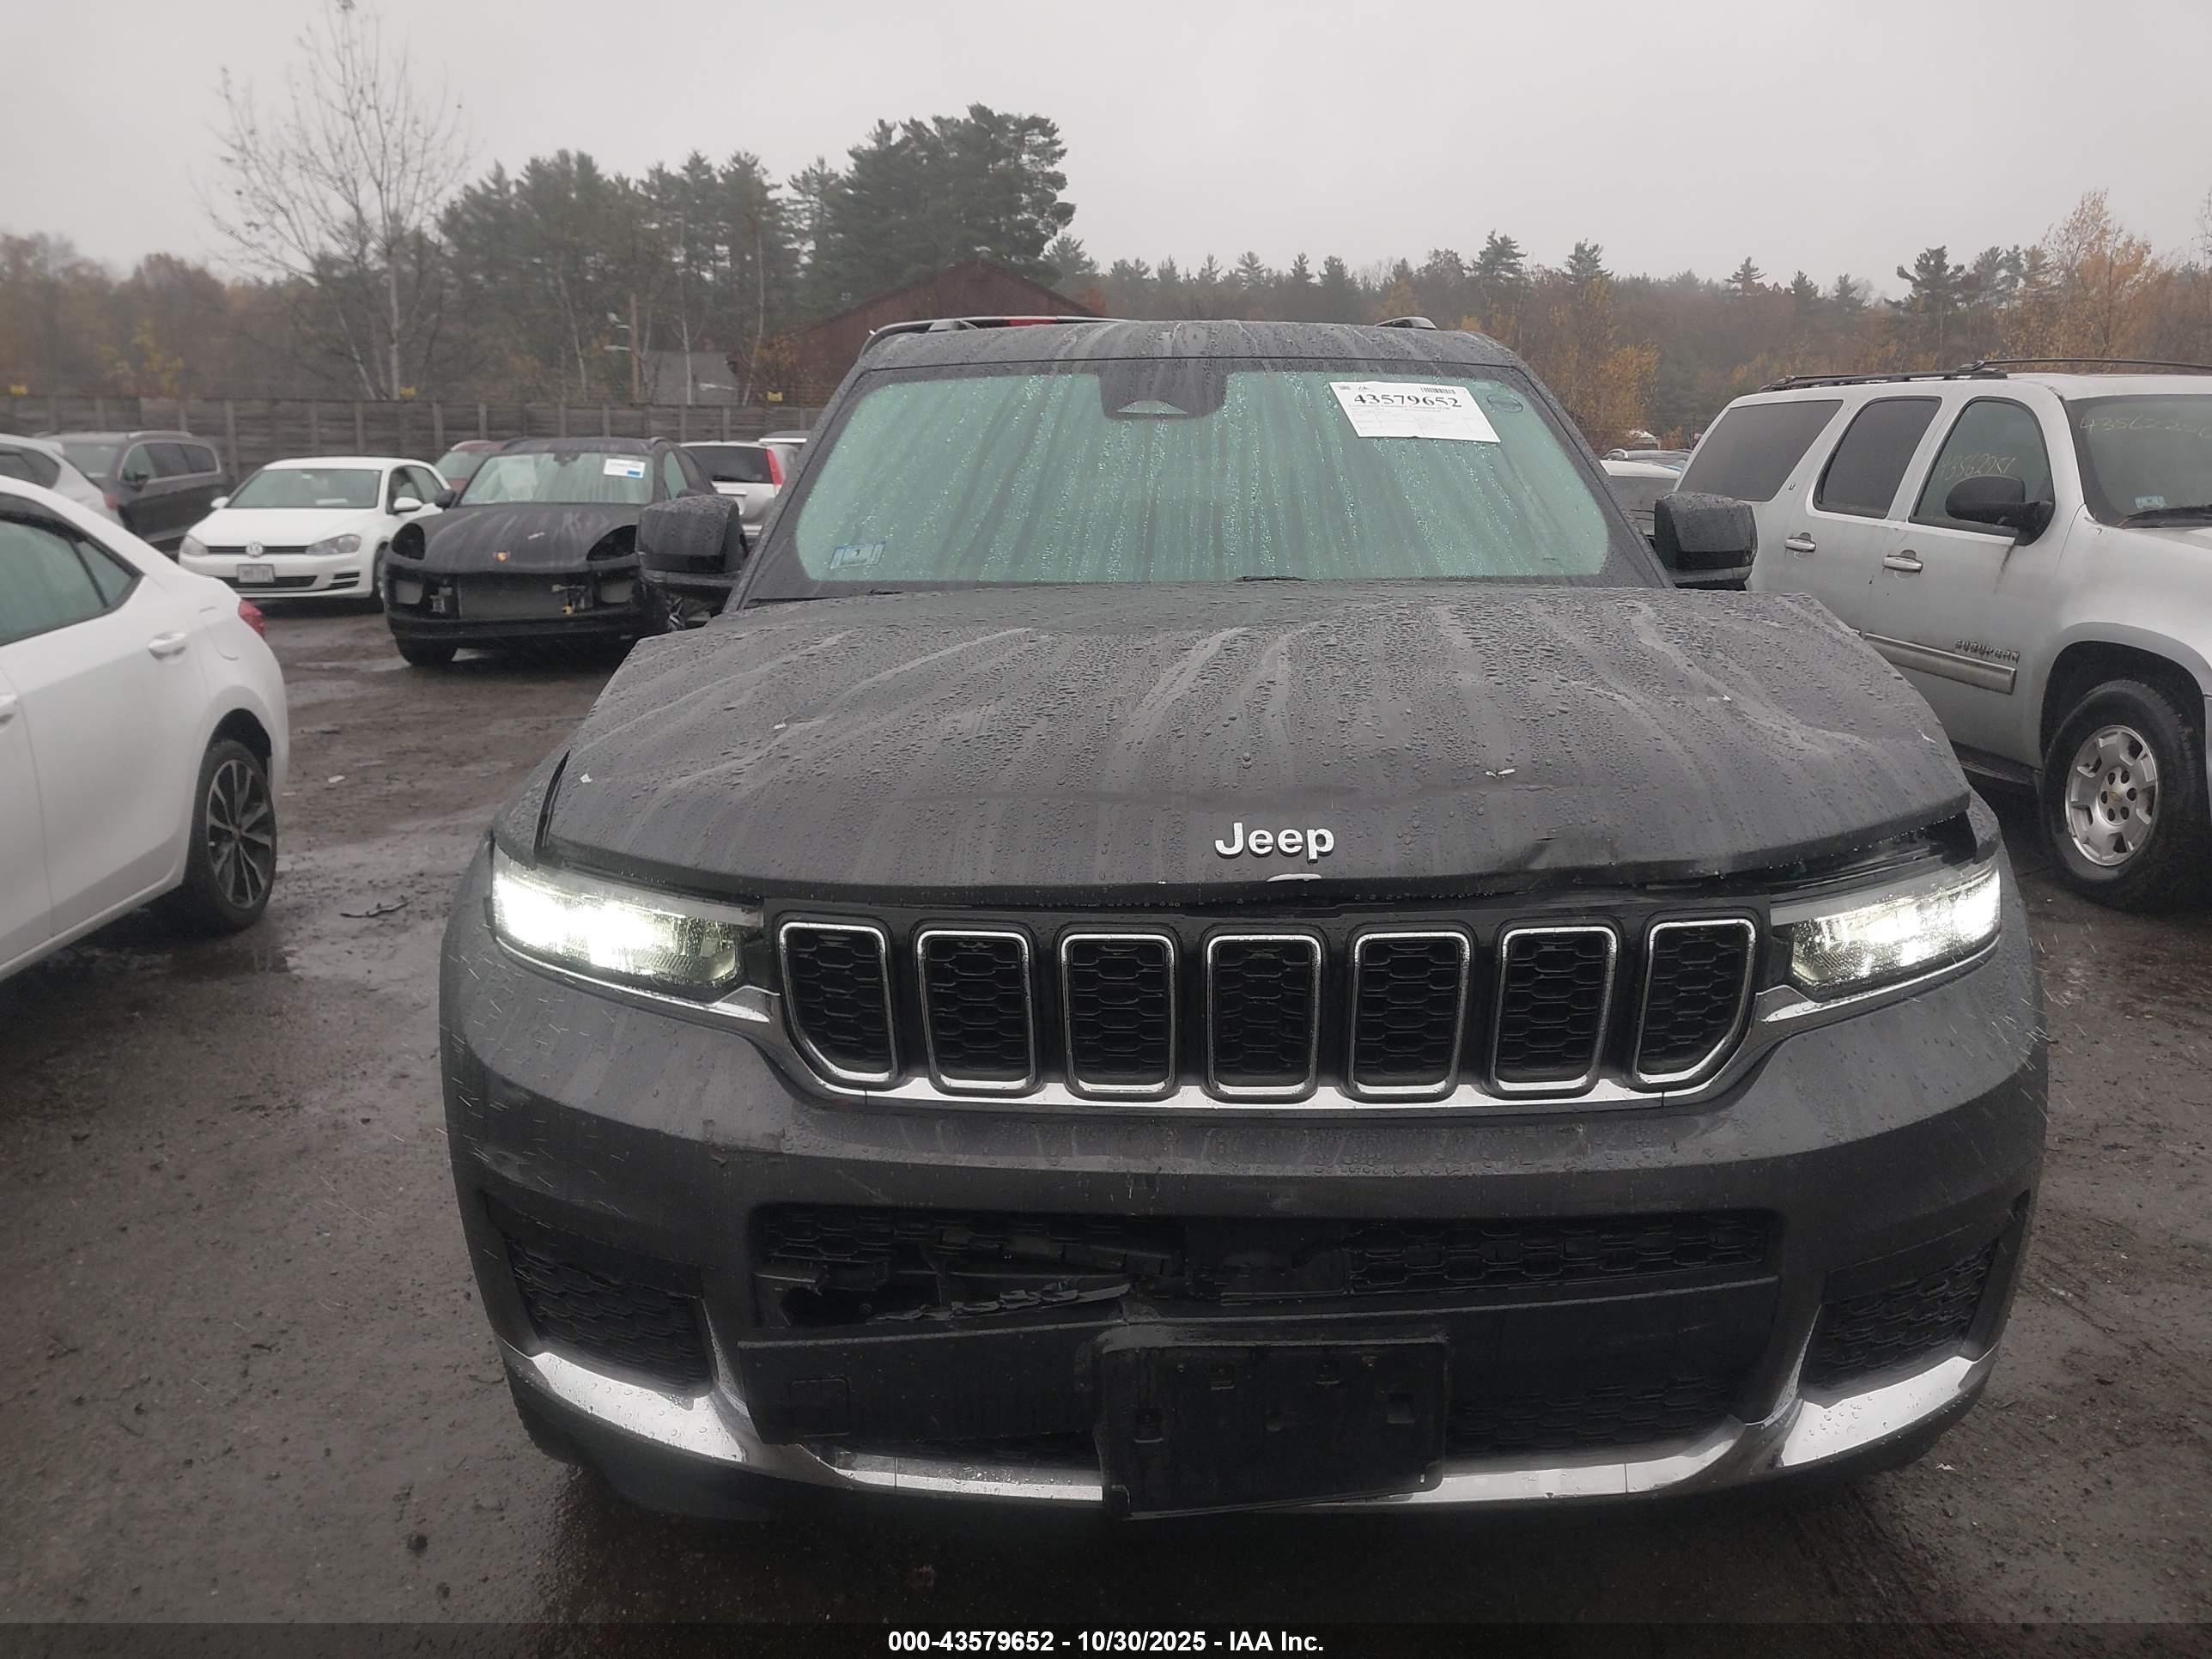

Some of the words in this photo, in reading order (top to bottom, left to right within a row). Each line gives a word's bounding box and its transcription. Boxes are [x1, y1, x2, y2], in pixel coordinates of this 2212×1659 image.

[1354, 394, 1462, 408] 43579652
[1954, 639, 2020, 664] SUBURBAN
[1215, 822, 1334, 862] Jeep
